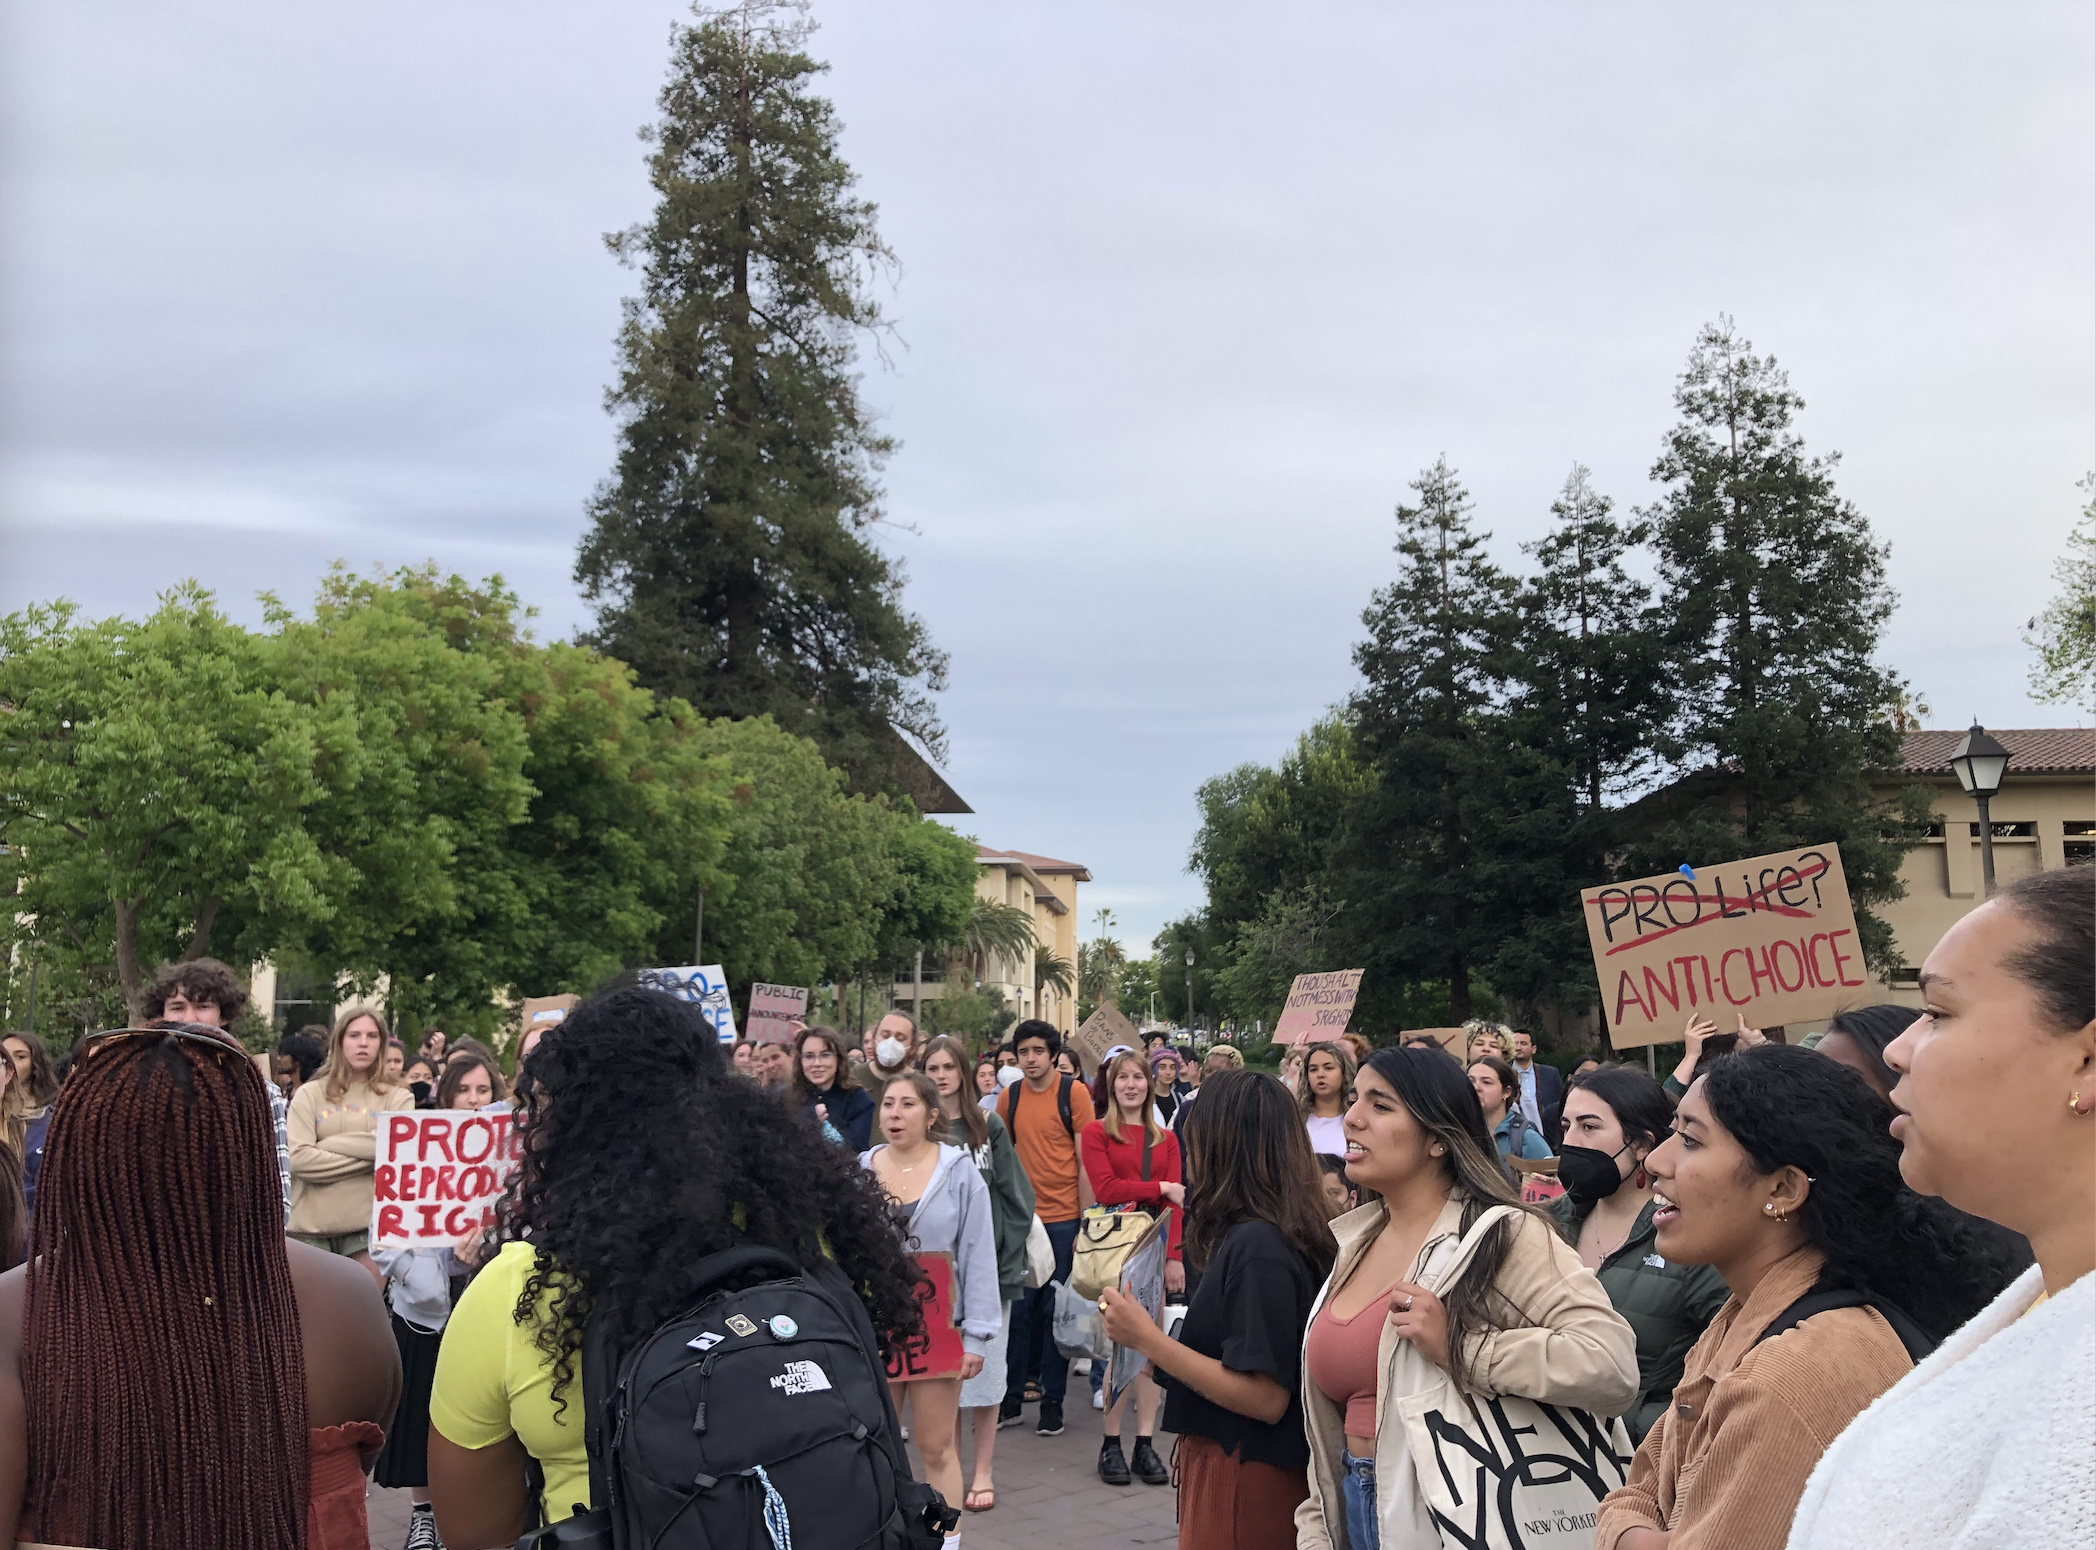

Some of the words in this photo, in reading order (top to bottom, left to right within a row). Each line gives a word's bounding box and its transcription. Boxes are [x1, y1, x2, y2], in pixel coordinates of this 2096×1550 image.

[1615, 929, 1865, 1025] ANTI-CHOICE
[755, 984, 805, 1001] PUBLIC
[784, 1360, 806, 1374] THE
[770, 1372, 809, 1389] NORTH
[785, 1381, 814, 1396] FACE
[1552, 1509, 1567, 1517] THE
[1524, 1519, 1552, 1537] NEW
